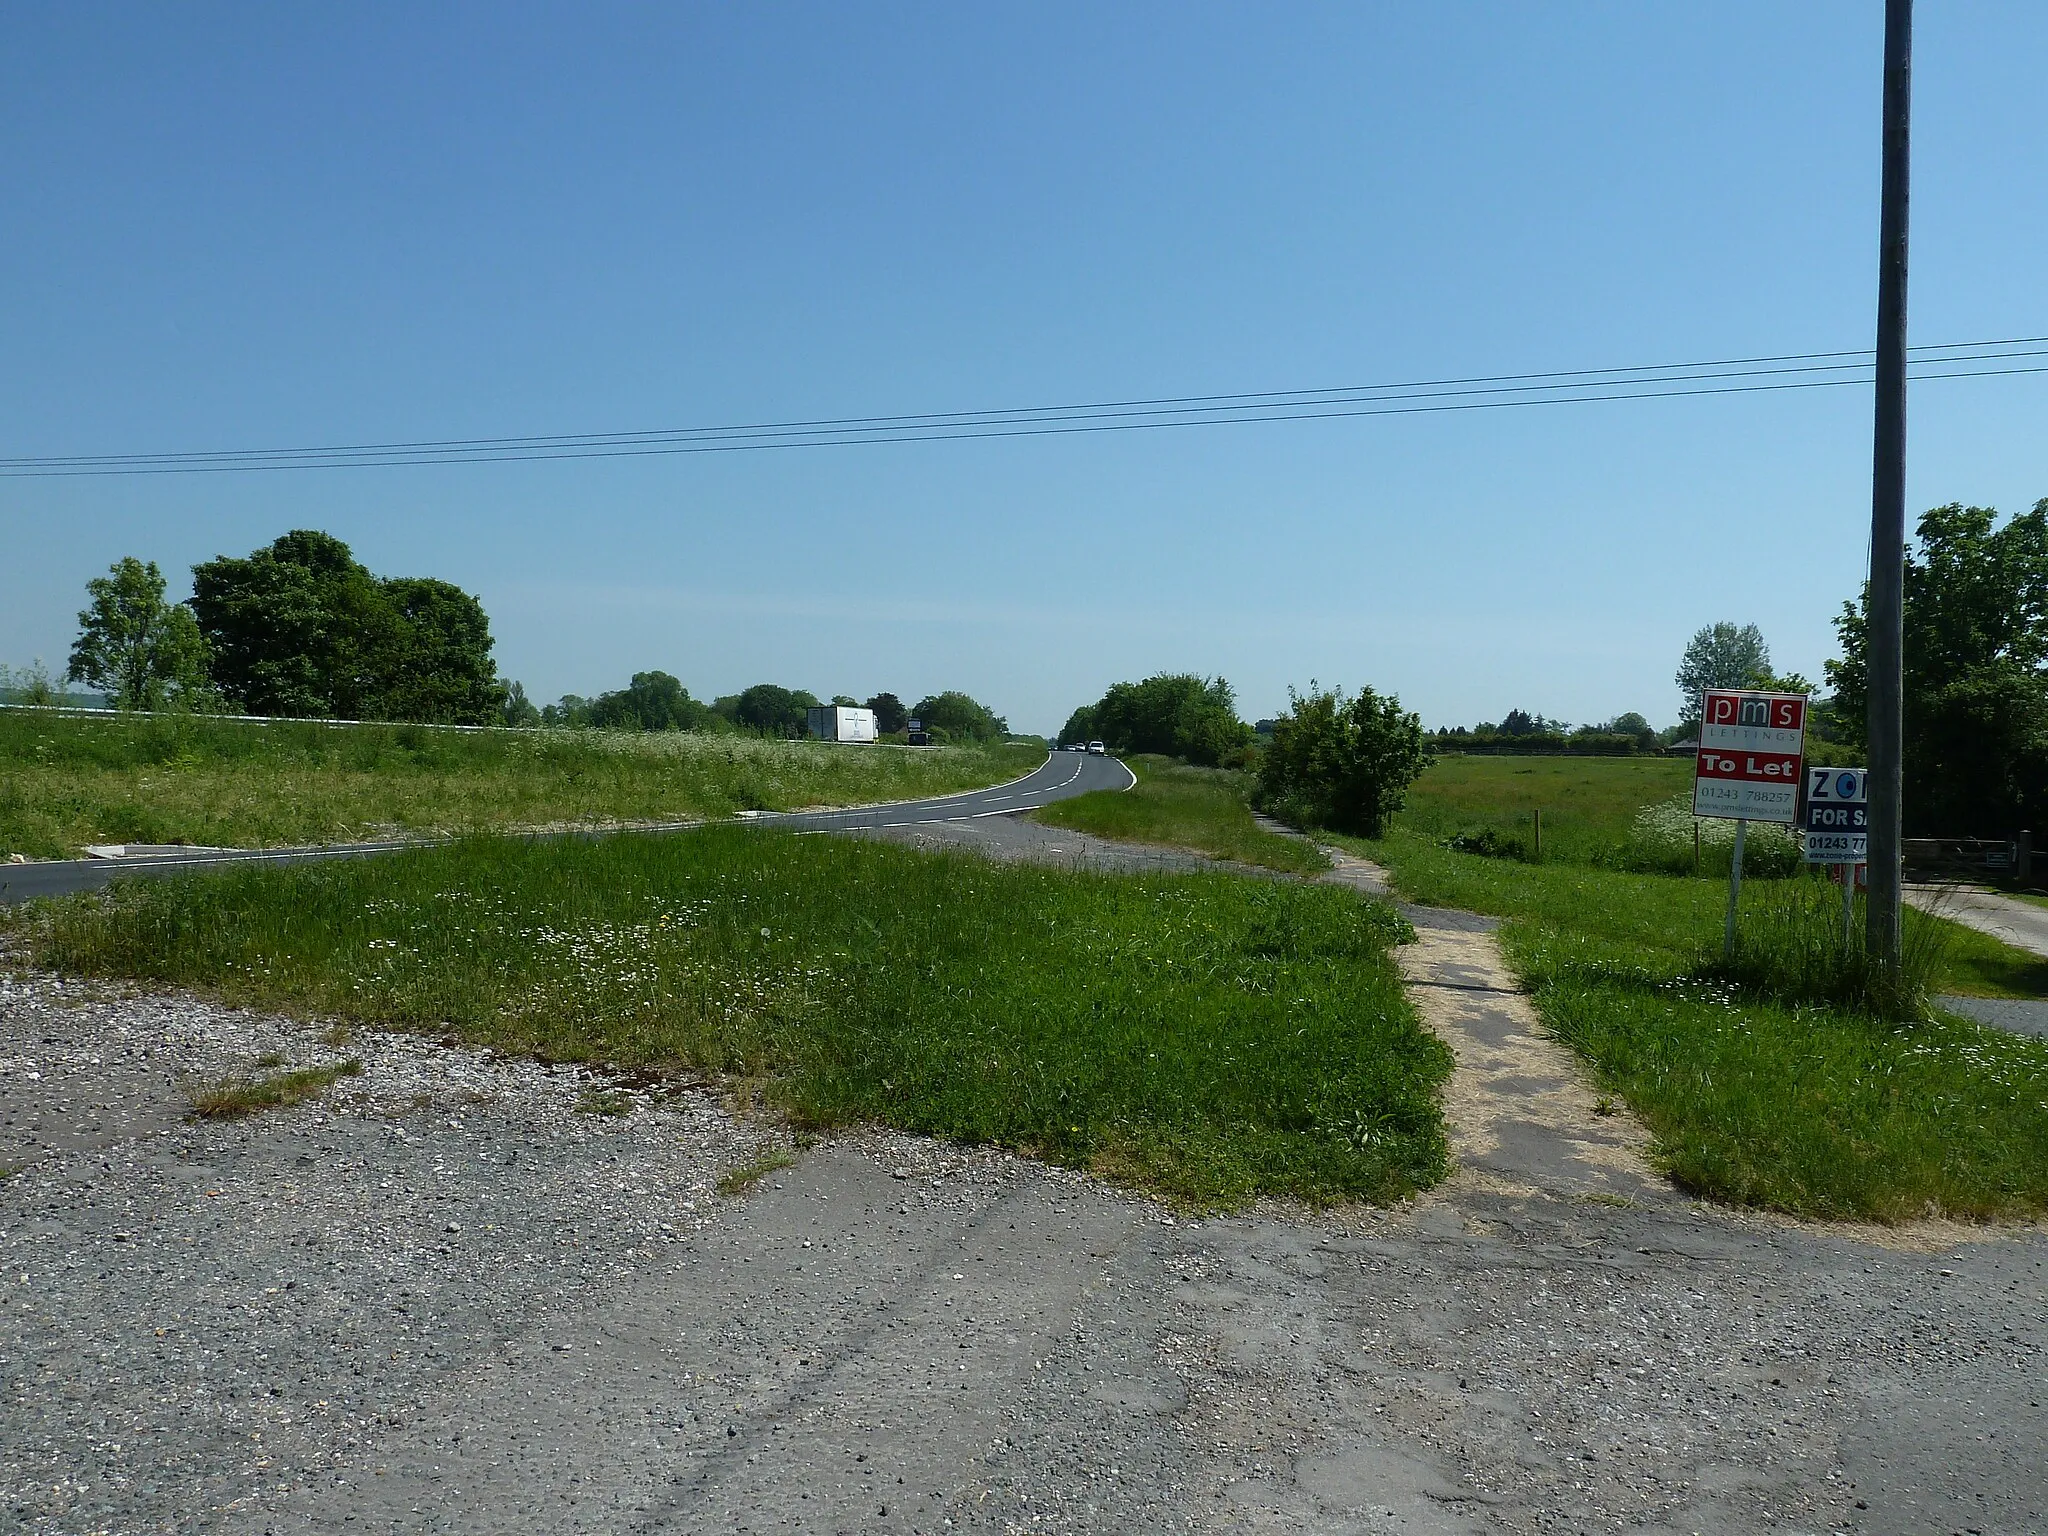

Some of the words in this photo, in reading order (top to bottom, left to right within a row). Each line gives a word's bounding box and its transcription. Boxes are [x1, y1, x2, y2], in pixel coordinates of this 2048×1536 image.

[1713, 698, 1793, 726] pms
[1710, 727, 1796, 742] LETTINGS
[1702, 754, 1736, 773] To
[1746, 757, 1793, 777] Let
[1701, 786, 1738, 800] 01243
[1746, 790, 1791, 803] 788257
[1811, 808, 1848, 826] FOR
[1809, 837, 1848, 850] 01243
[1852, 838, 1867, 850] 77
